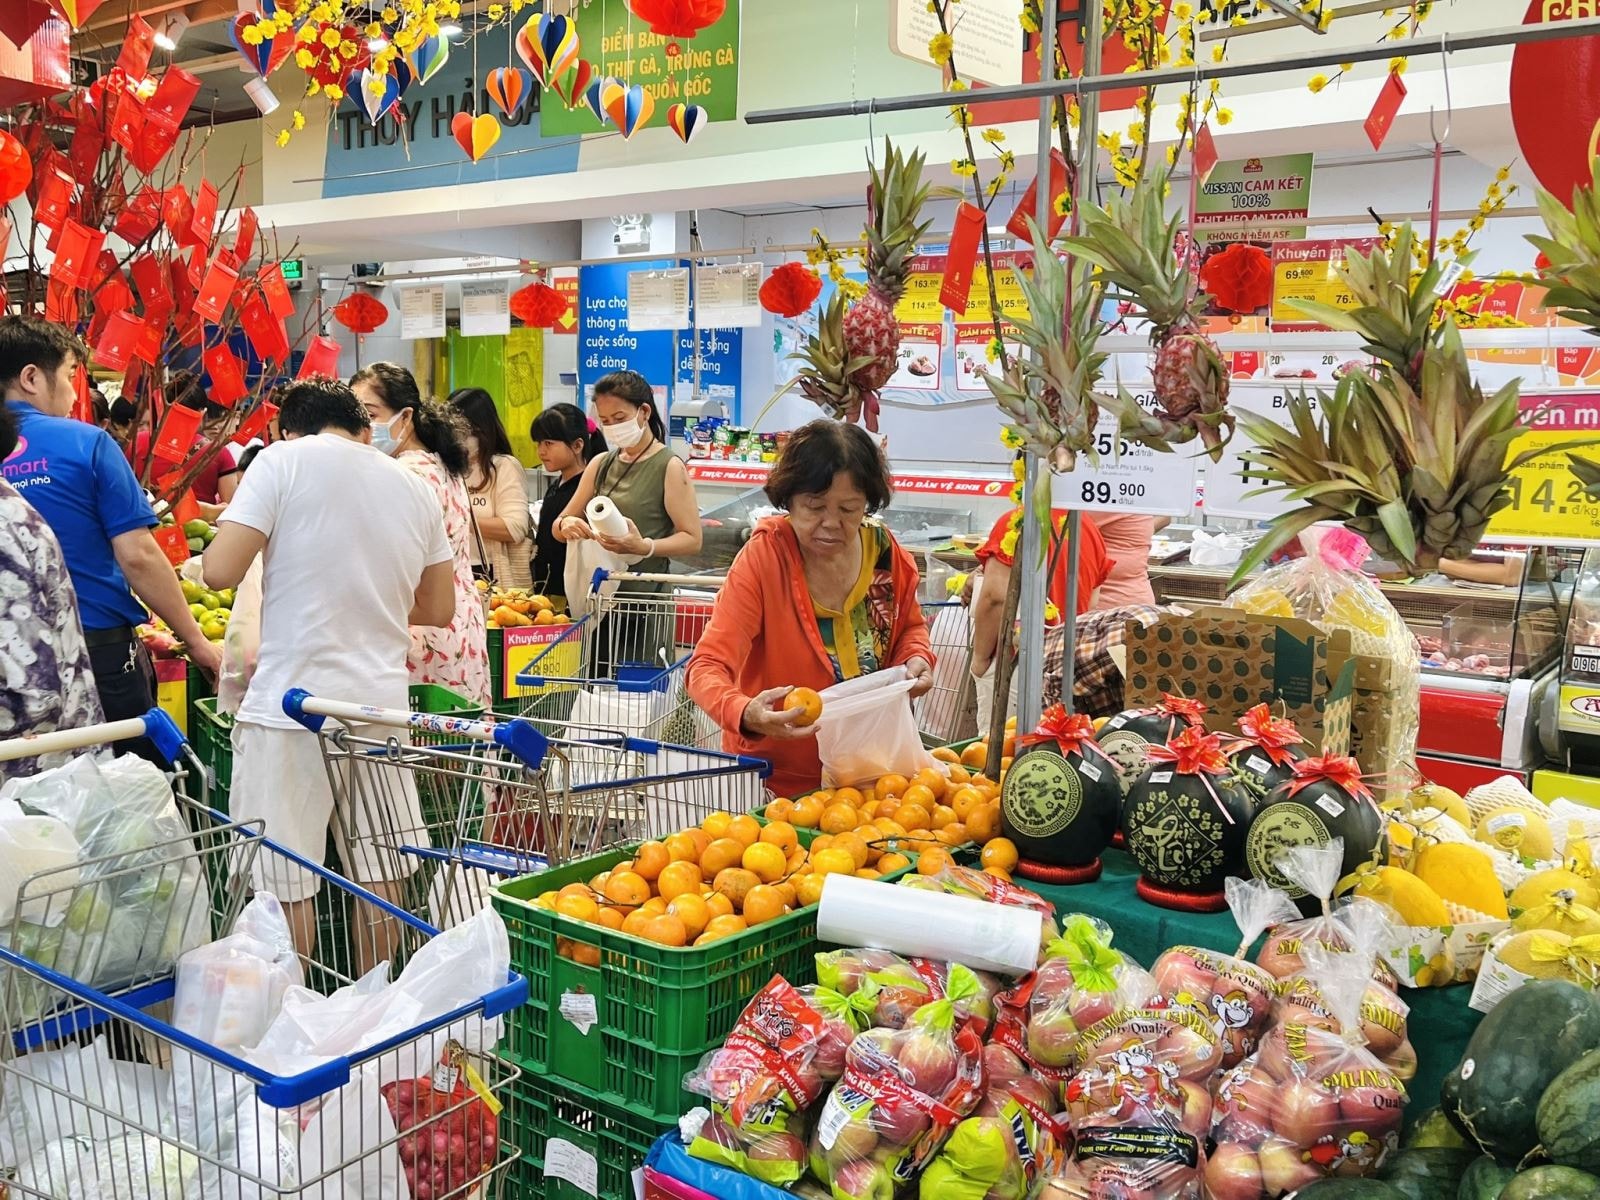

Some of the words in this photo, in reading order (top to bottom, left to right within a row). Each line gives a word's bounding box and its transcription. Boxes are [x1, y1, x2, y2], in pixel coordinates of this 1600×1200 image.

[601, 27, 634, 53] ĐIỂM
[715, 43, 734, 66] GÀ
[1203, 182, 1243, 194] VISSAN
[1244, 180, 1274, 192] CAM
[1278, 173, 1303, 191] KẾT
[1231, 193, 1271, 209] 100%
[587, 297, 605, 312] Lựa
[608, 295, 628, 311] chọ
[587, 318, 616, 331] thông
[586, 336, 610, 350] cuộc
[612, 333, 637, 350] sống
[586, 353, 599, 368] dễ
[601, 355, 627, 371] dàng
[30, 476, 51, 486] nhà
[954, 483, 981, 492] SINH
[508, 630, 544, 645] Khuyến
[1029, 1106, 1053, 1128] KÈM
[1109, 1145, 1135, 1154] Family
